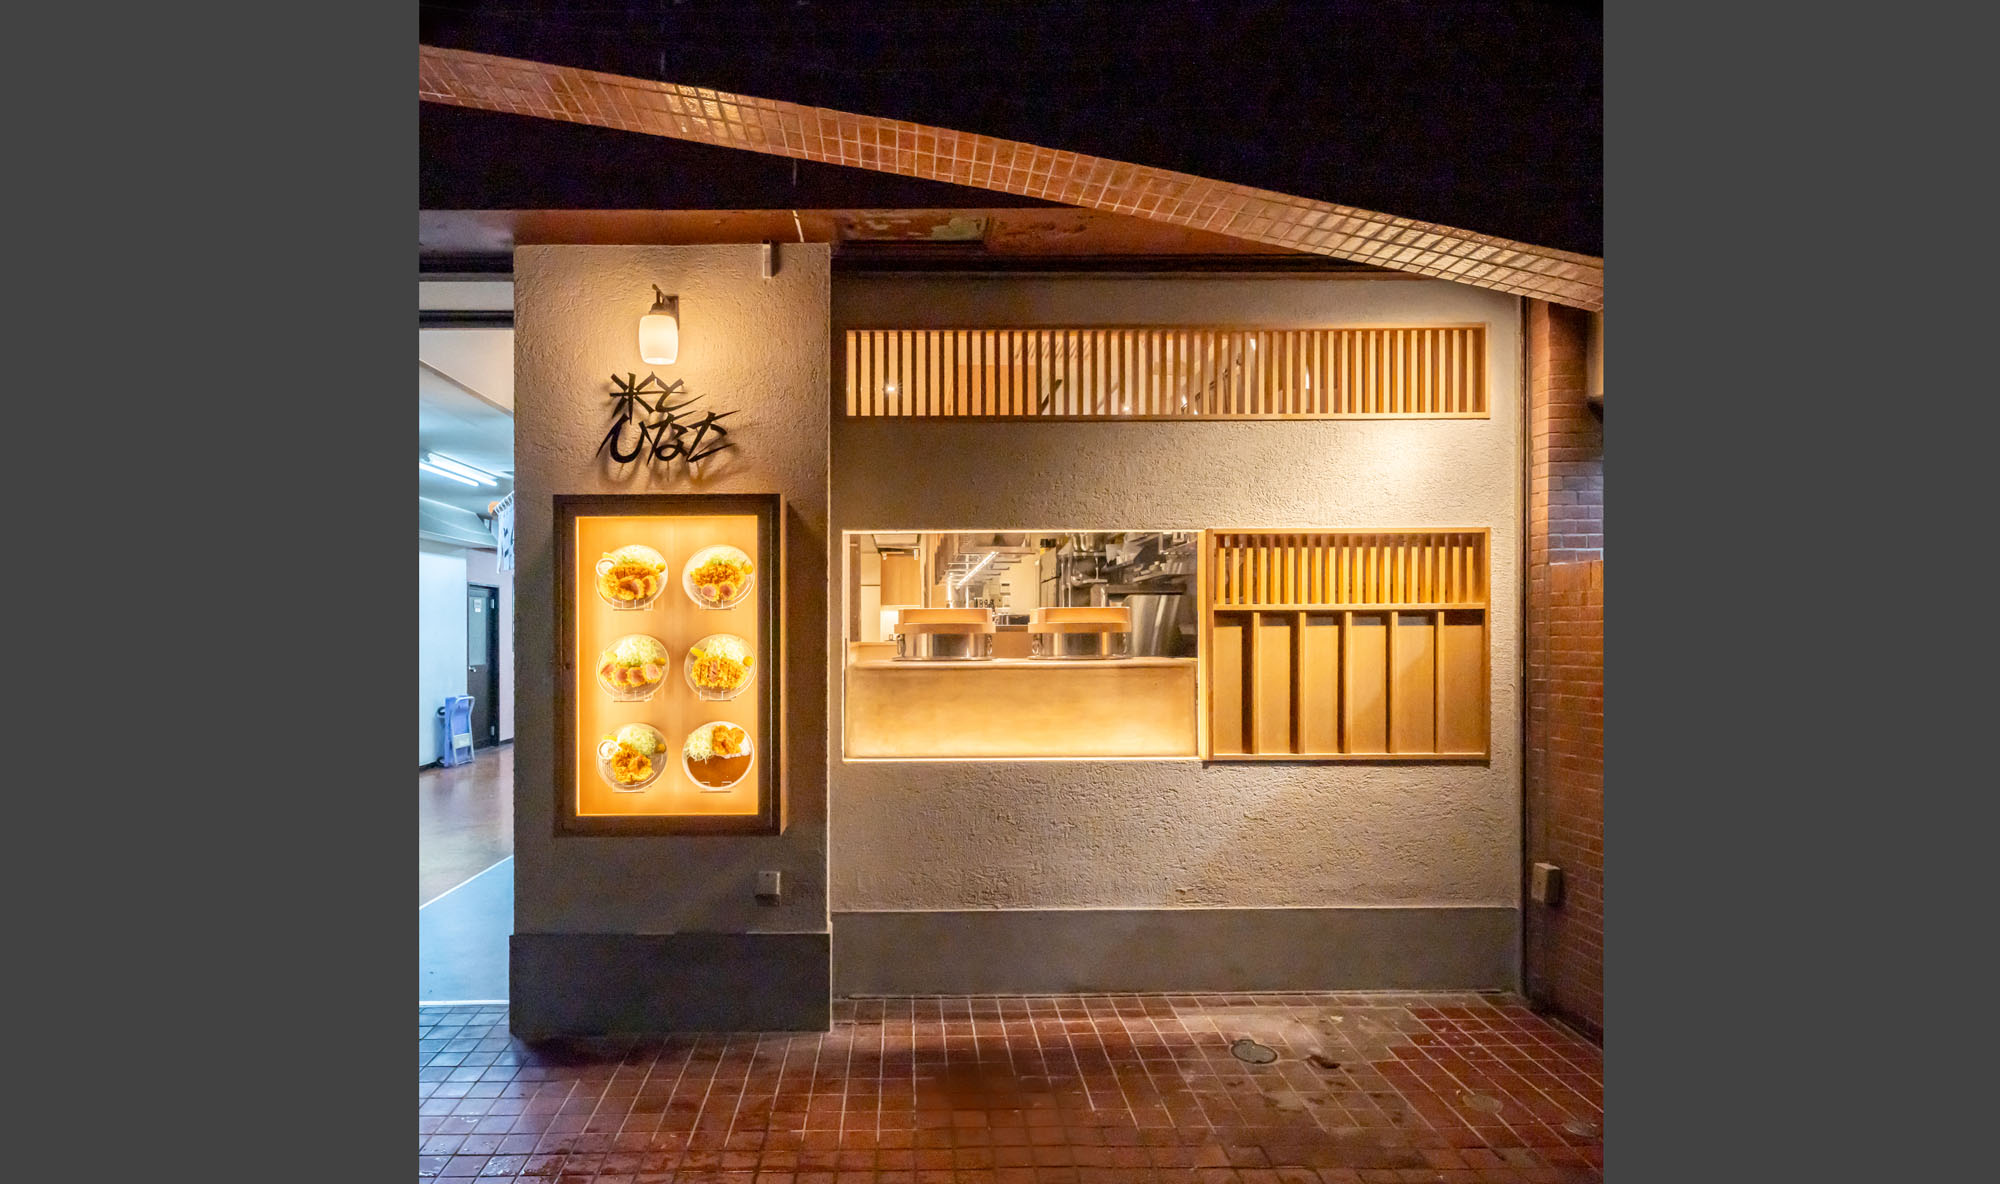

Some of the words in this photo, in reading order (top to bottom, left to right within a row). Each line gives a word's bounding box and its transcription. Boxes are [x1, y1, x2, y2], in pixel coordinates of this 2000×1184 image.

[609, 371, 706, 424] 米と
[596, 410, 741, 466] ひなた
